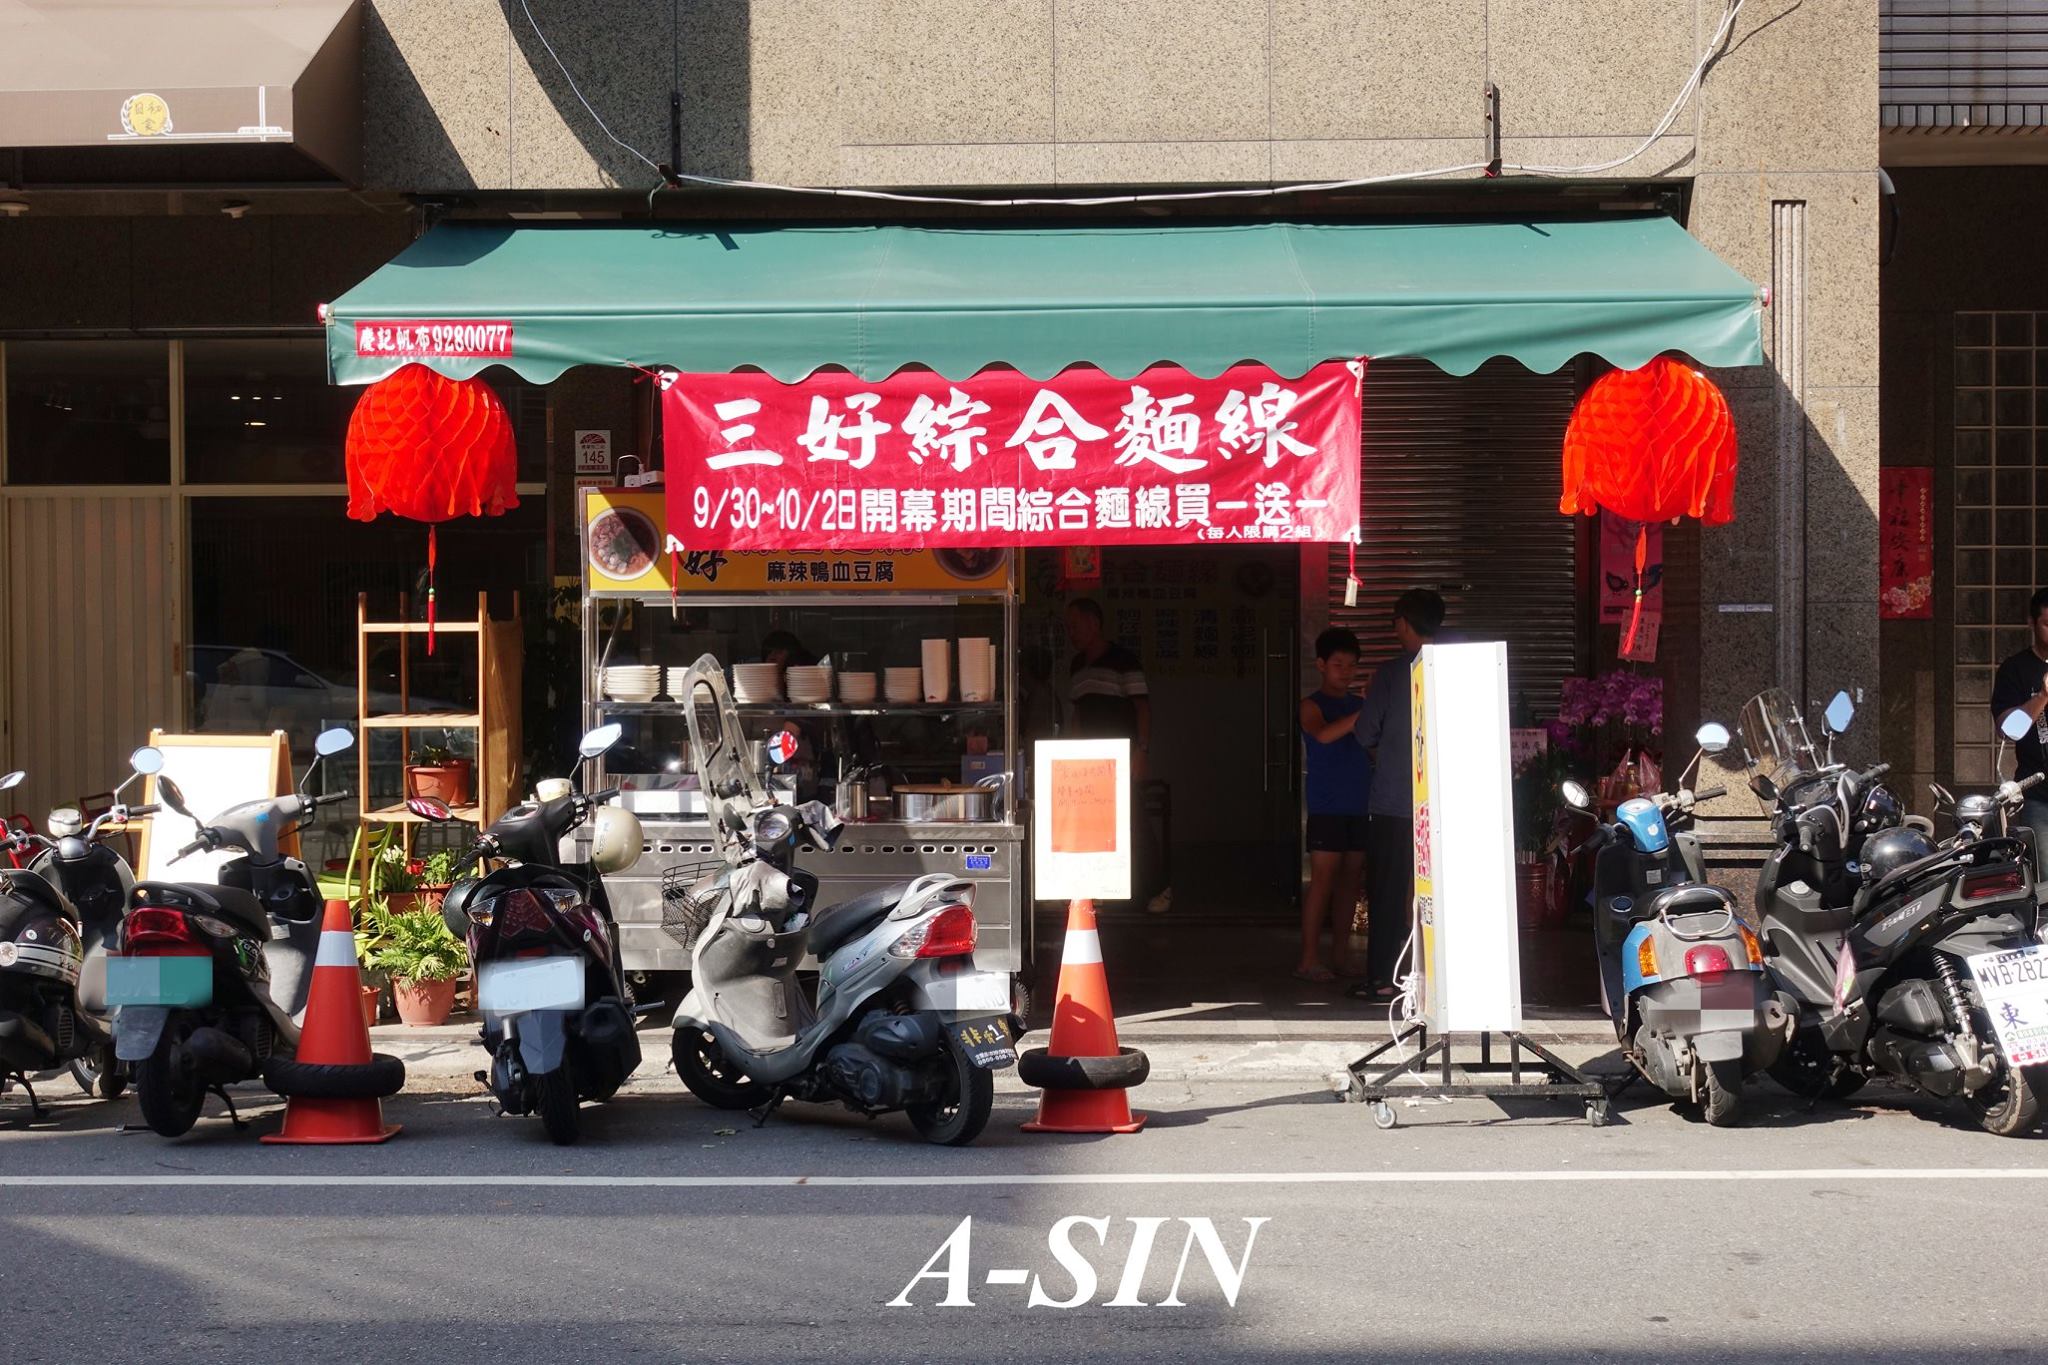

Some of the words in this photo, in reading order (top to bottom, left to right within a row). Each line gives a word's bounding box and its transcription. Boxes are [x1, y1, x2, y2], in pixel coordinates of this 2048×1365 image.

[706, 382, 1318, 475] 三好綜合麵線
[582, 450, 605, 464] 145
[693, 481, 1328, 533] 9/30~10/2日開幕期間綜合麵線買一送一
[767, 561, 894, 582] 麻辣鴨血豆腐
